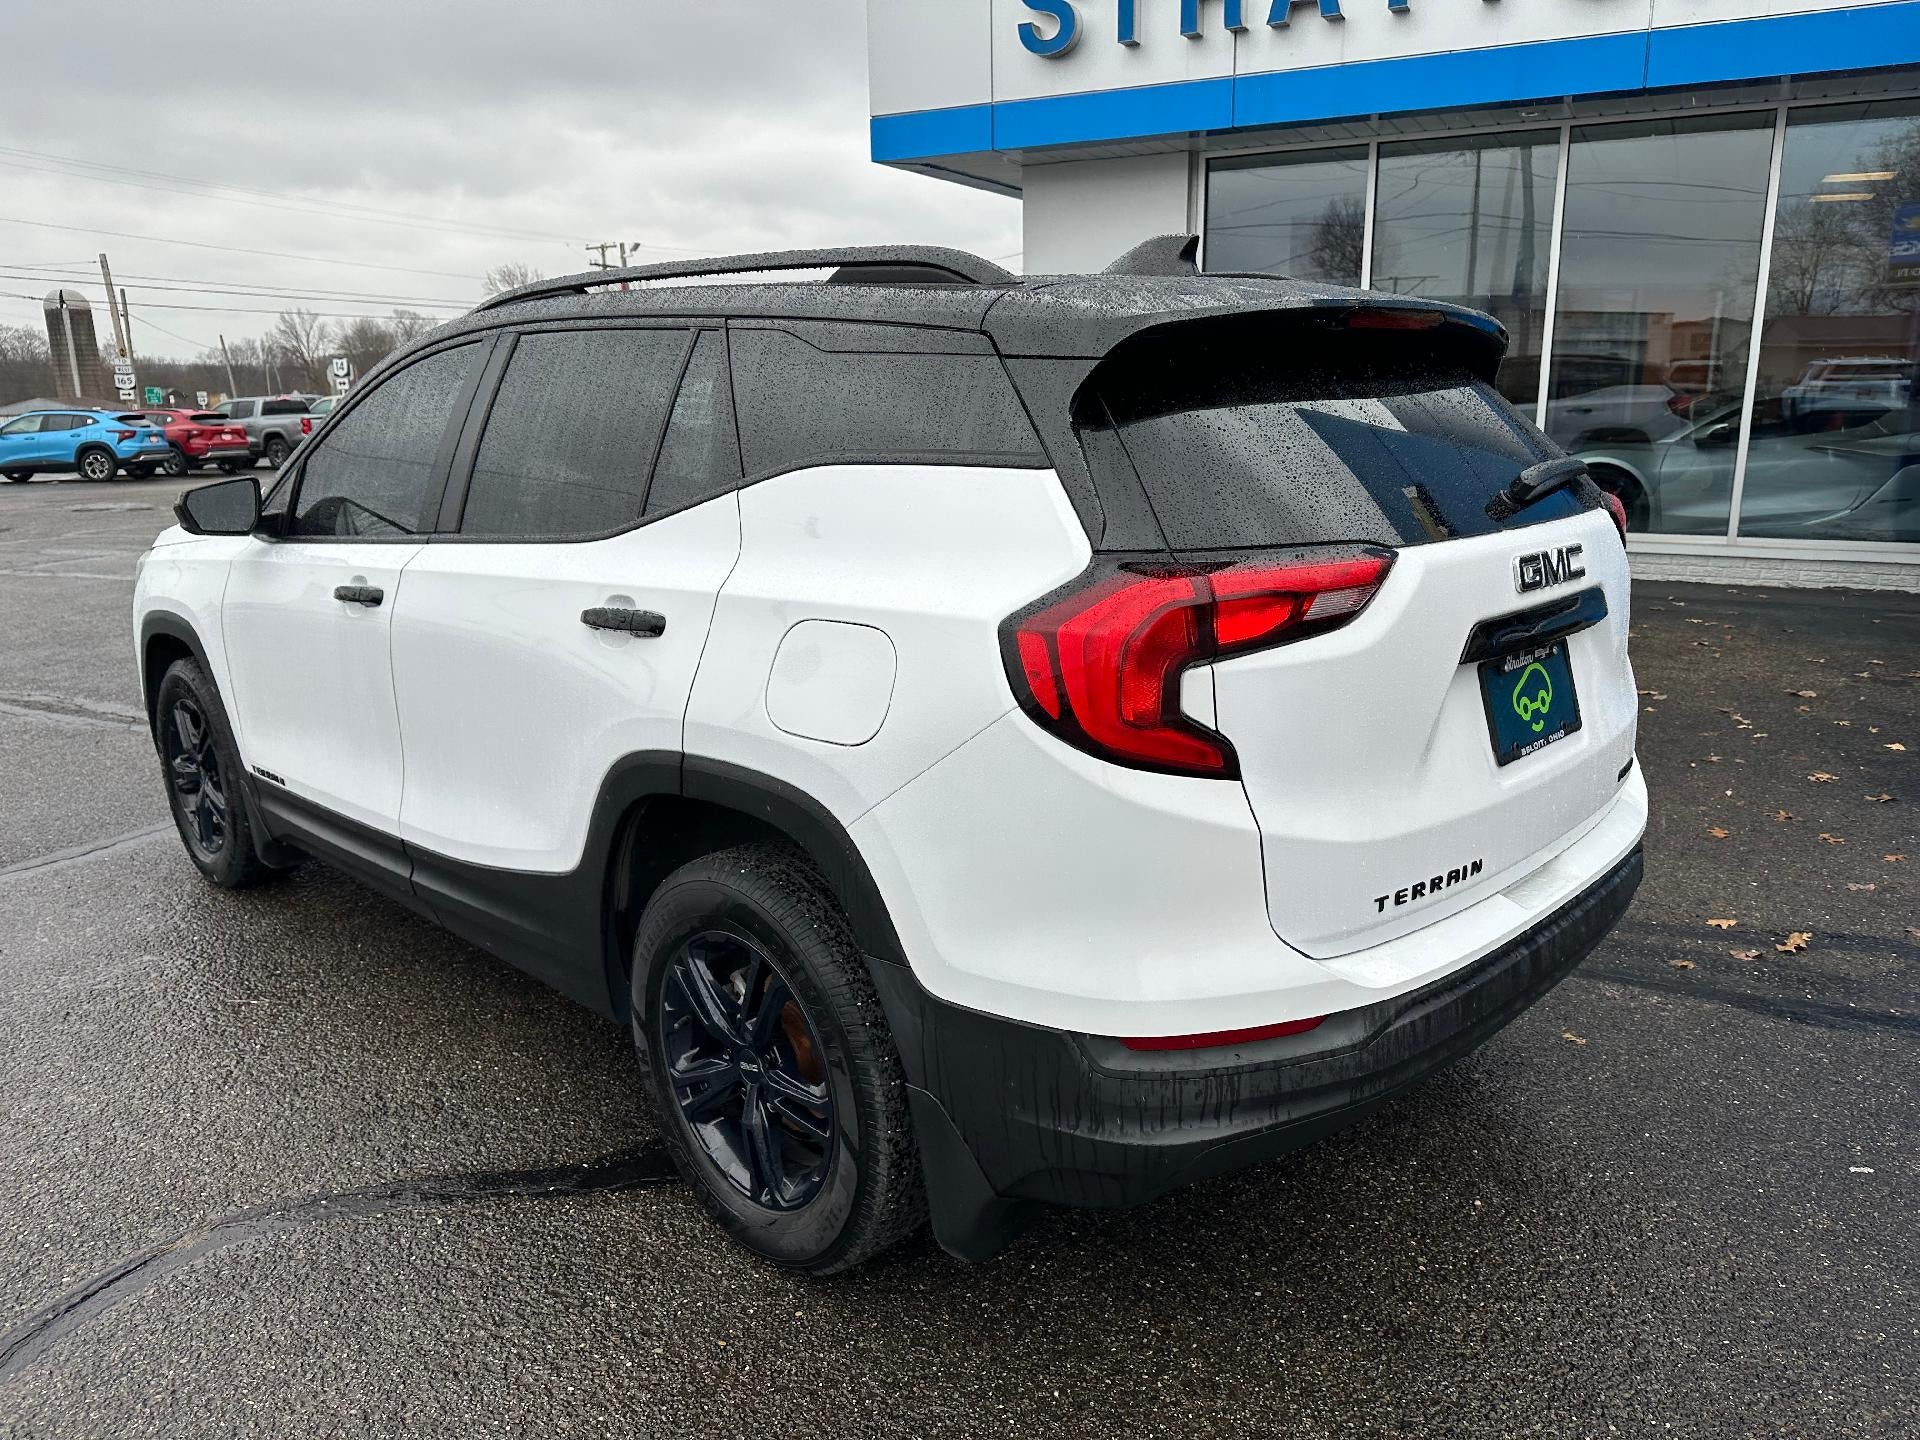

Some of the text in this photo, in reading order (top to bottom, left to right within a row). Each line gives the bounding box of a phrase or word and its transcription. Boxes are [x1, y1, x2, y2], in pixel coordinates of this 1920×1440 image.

[335, 361, 345, 371] 14
[117, 377, 133, 385] 165
[1513, 543, 1586, 593] GMC
[1548, 730, 1565, 743] OHIO
[1374, 859, 1483, 913] TERRAIN
